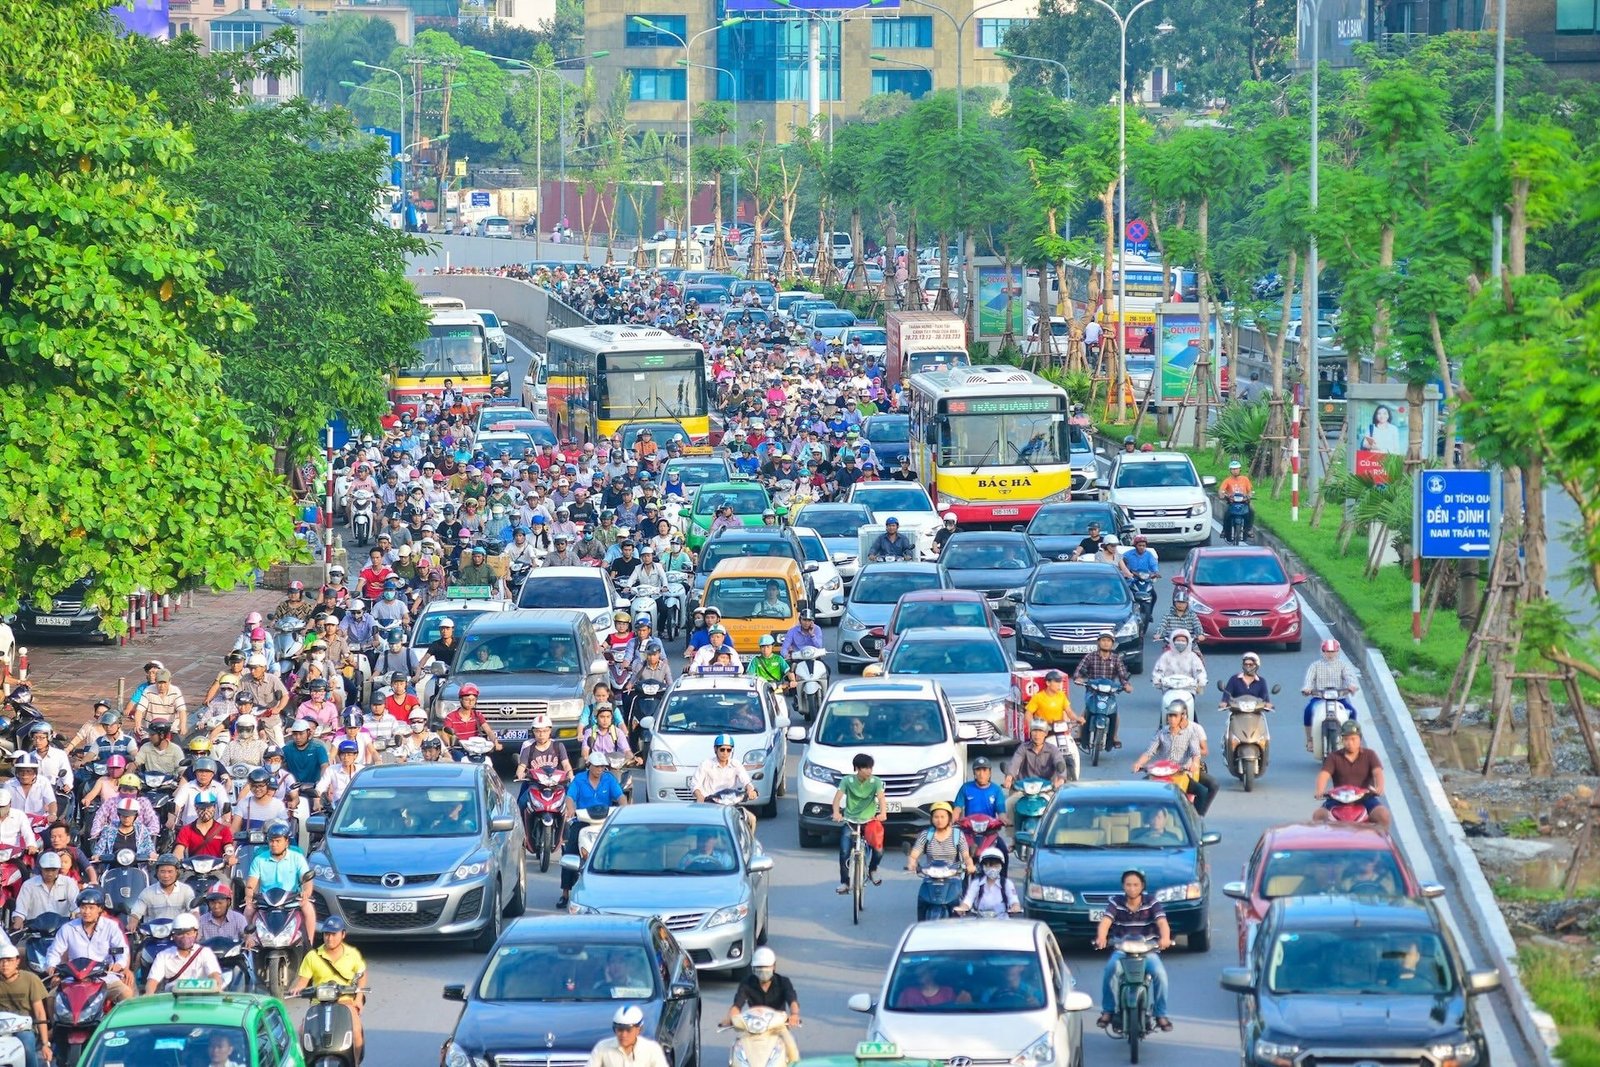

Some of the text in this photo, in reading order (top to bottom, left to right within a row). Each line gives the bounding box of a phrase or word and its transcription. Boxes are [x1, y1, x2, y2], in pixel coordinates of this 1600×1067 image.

[1011, 476, 1032, 486] HÀ
[1444, 493, 1490, 503] DI TÍCH QU
[1427, 504, 1449, 523] ĐỀN
[1457, 506, 1484, 523] ĐÌNH
[1430, 529, 1450, 538] NAM
[1452, 526, 1475, 538] TRẤN
[179, 979, 212, 988] TAXI
[863, 1043, 895, 1054] TAXI
